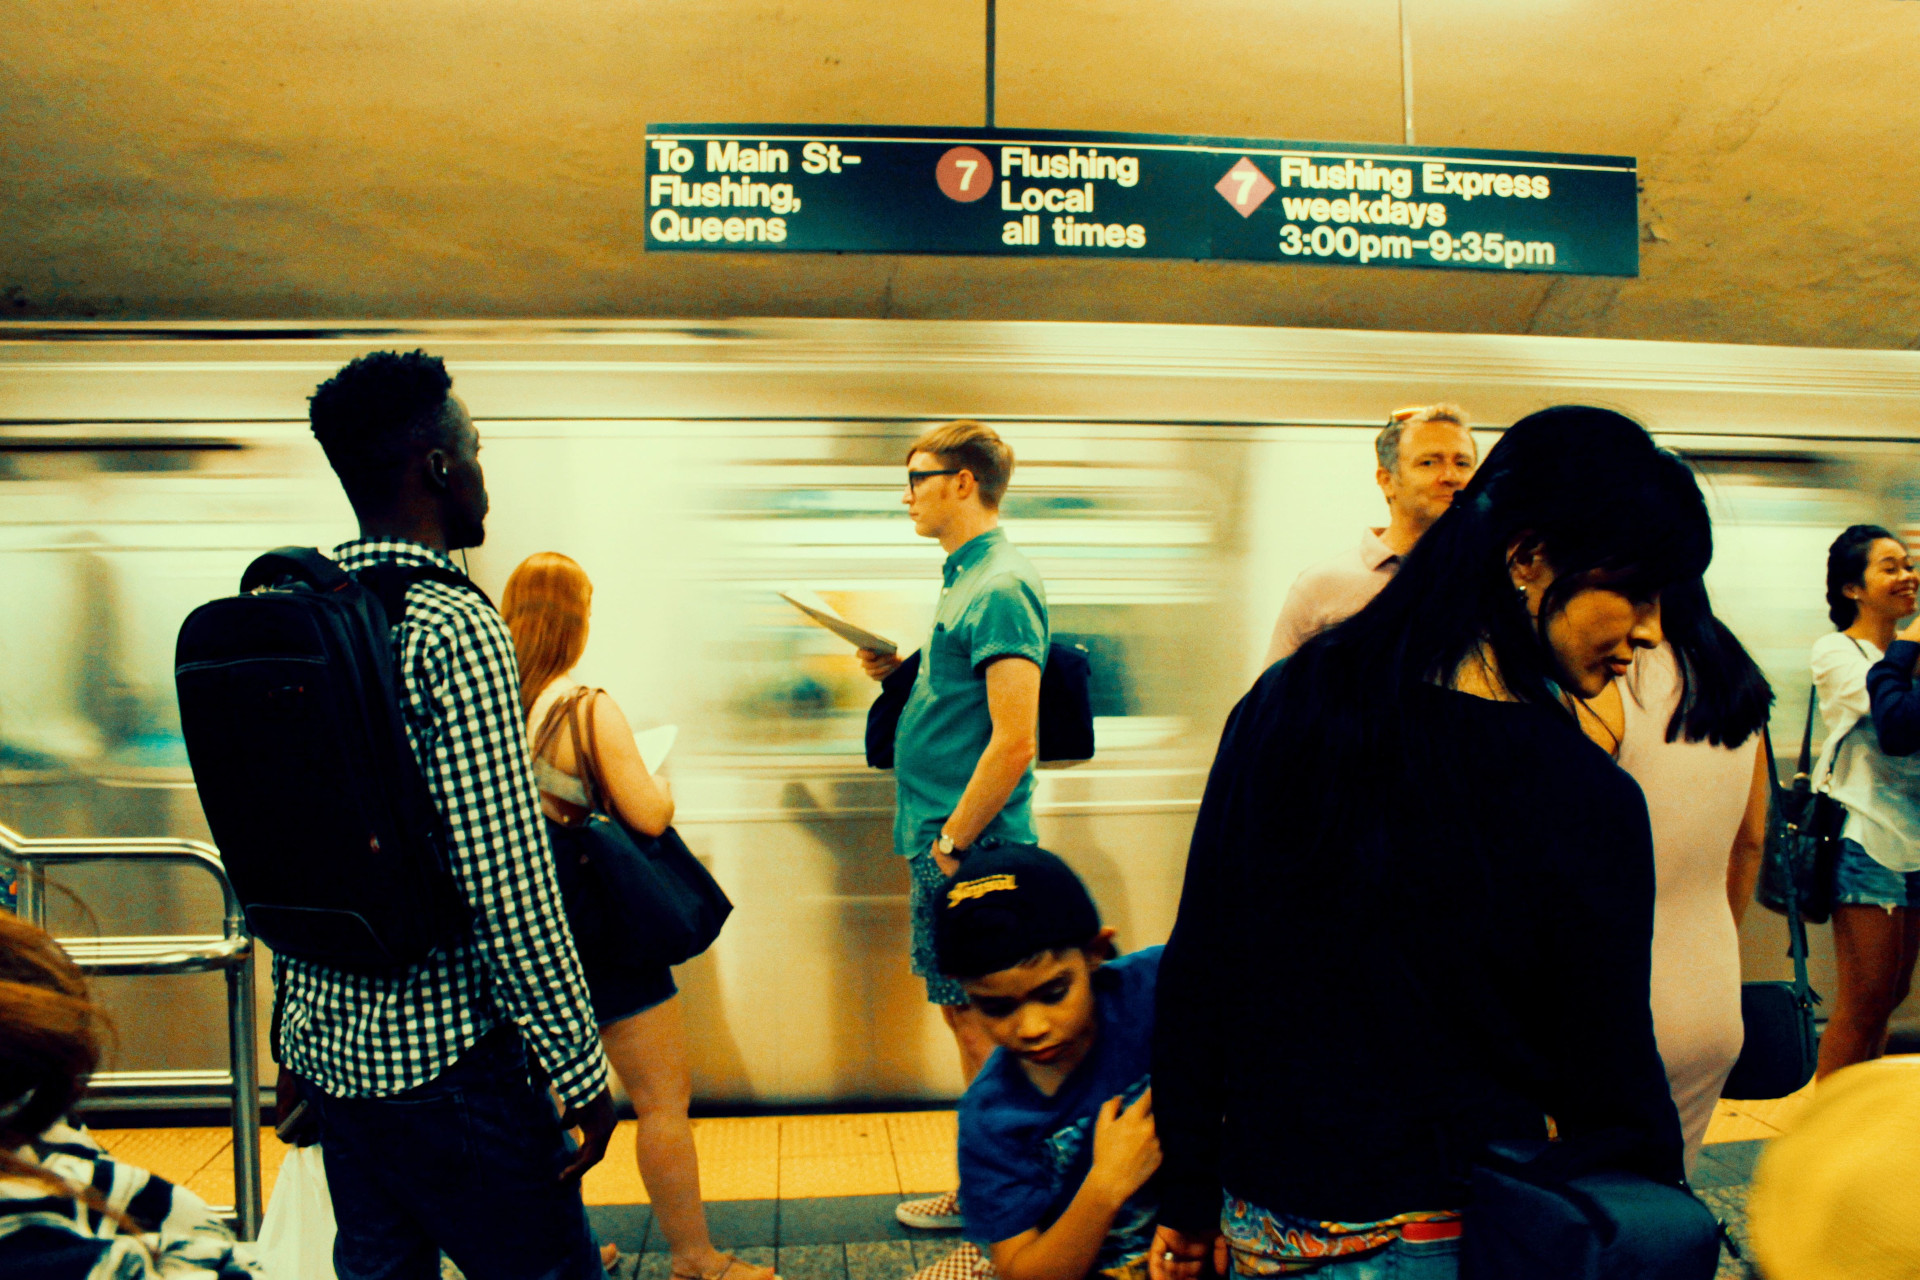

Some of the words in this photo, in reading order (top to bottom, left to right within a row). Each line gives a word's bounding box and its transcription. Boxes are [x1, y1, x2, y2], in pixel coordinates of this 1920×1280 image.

[651, 140, 695, 173] To
[706, 141, 789, 173] Main
[1001, 146, 1140, 187] Flushing
[955, 160, 979, 191] 7
[1231, 171, 1259, 205] 7
[1279, 157, 1413, 198] Flushing
[1422, 163, 1551, 200] Express
[650, 175, 802, 214] Flushing,
[1001, 180, 1094, 212] Local
[1282, 193, 1448, 228] weekdays
[649, 209, 787, 243] Queens
[1001, 214, 1040, 245] all
[1052, 216, 1147, 249] times
